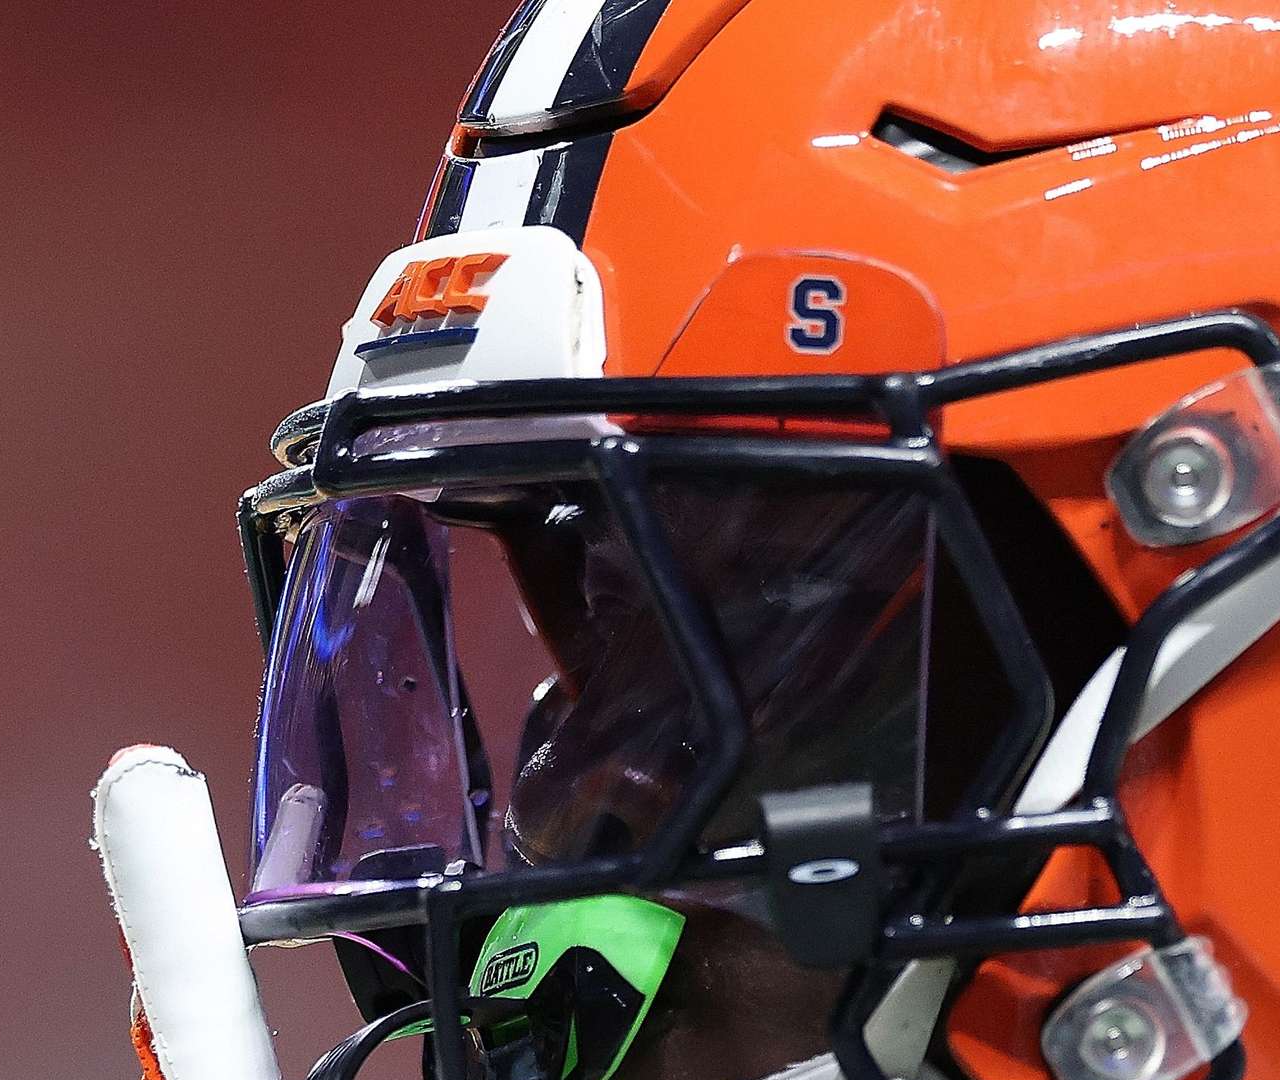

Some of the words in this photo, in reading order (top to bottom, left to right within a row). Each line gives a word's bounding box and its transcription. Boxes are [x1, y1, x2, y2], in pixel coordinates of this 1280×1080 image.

[370, 253, 510, 328] ACC
[784, 274, 847, 355] S
[485, 950, 533, 988] BATTLE
